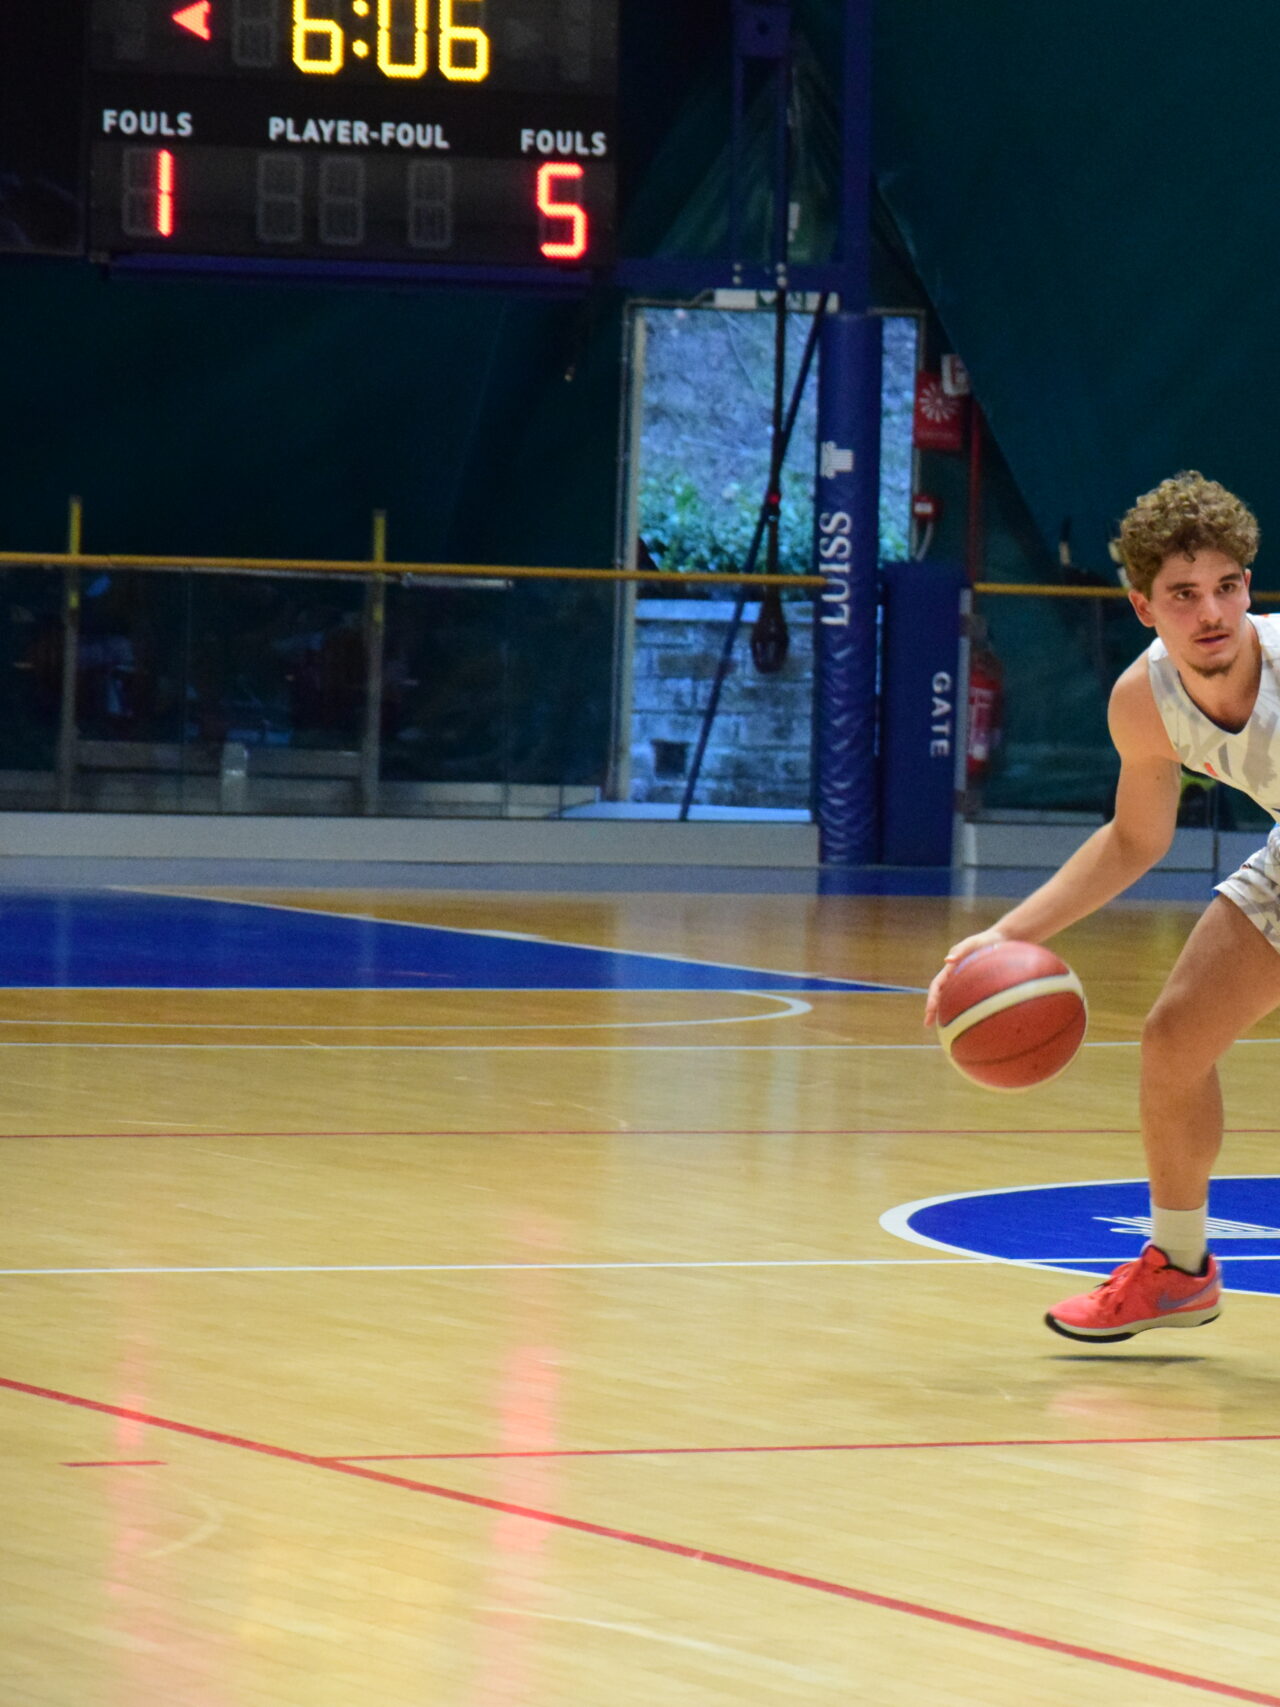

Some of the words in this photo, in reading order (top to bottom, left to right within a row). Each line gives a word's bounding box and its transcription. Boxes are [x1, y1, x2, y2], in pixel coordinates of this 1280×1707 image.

[103, 109, 193, 137] FOULS
[268, 117, 450, 150] PLAYER-FOUL
[520, 128, 607, 156] FOULS
[157, 149, 174, 238] 1
[536, 162, 588, 259] 5
[819, 511, 853, 627] LUISS
[930, 671, 952, 757] GATE
